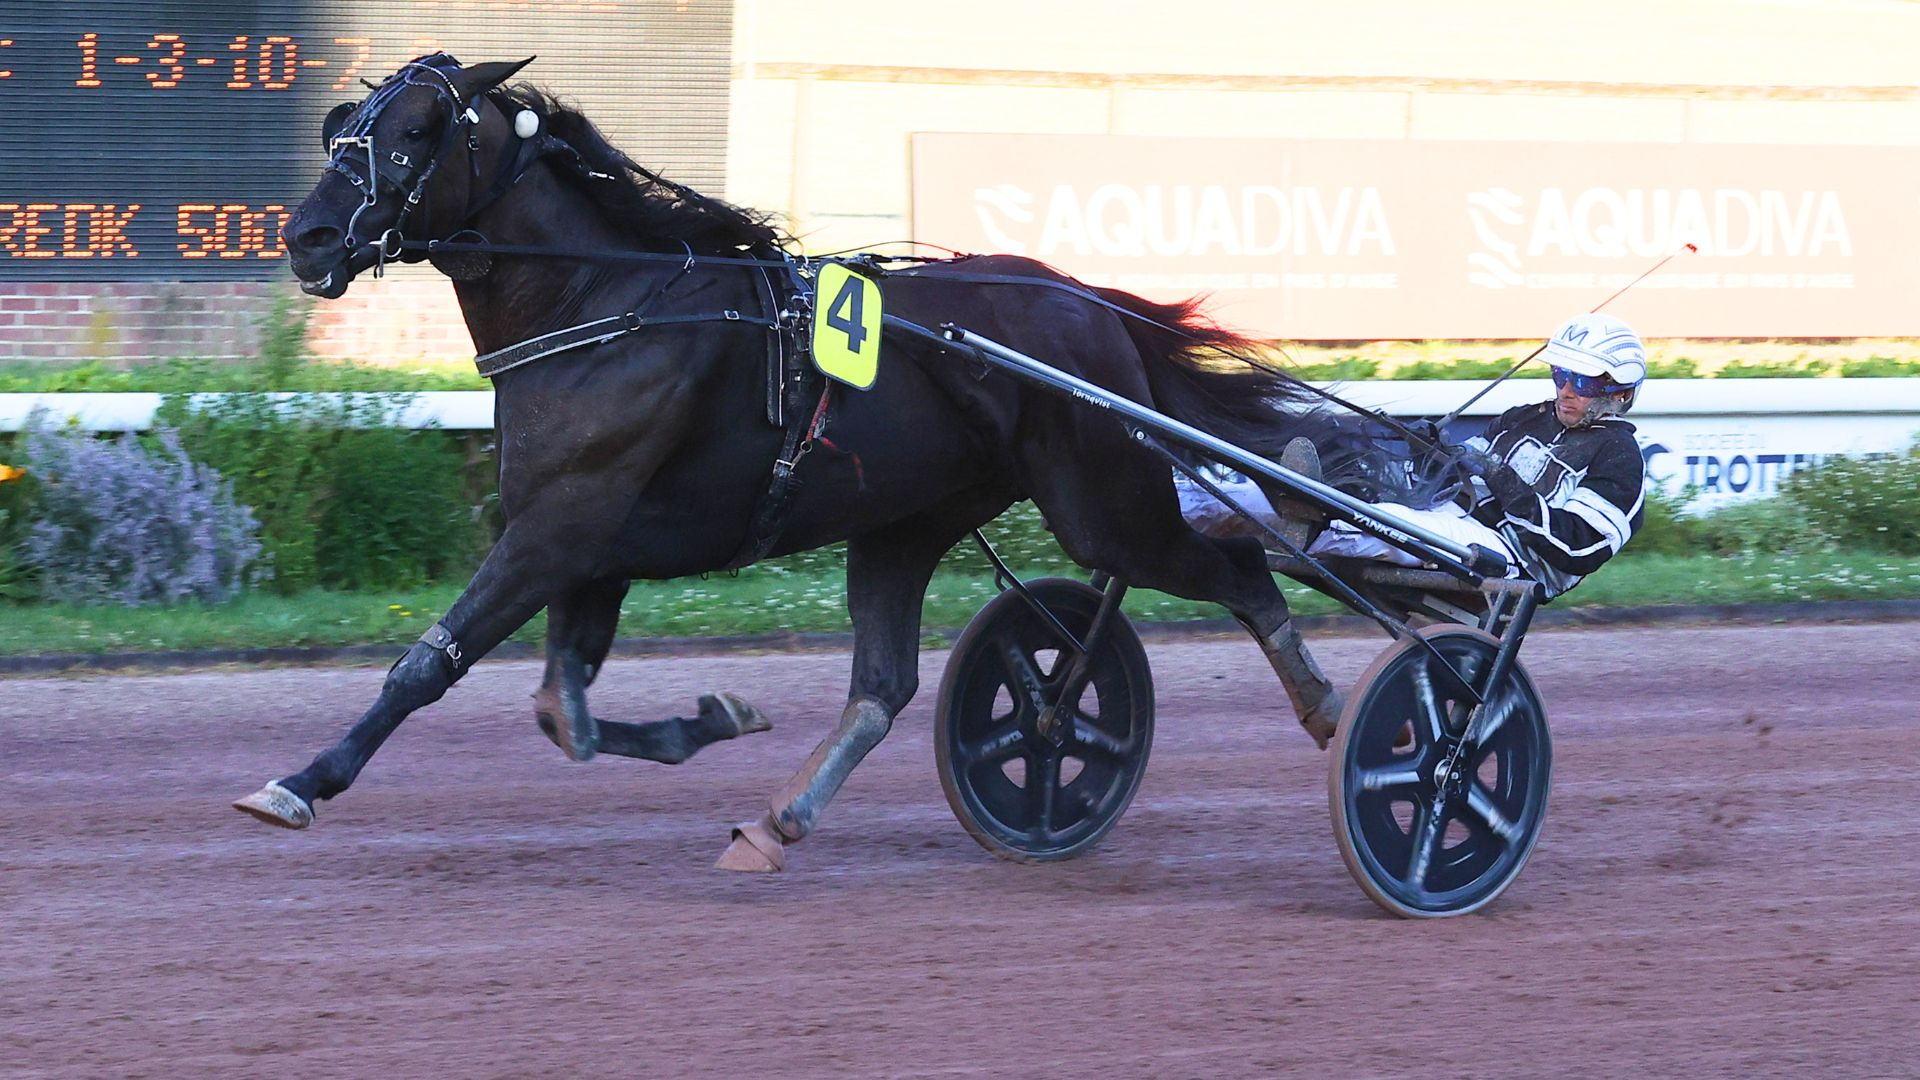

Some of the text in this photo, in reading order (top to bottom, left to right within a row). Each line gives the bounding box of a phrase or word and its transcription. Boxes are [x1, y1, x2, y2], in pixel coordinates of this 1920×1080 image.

[1038, 184, 1397, 258] AQUADIVA
[1526, 187, 1855, 258] AQUADIVA
[826, 274, 867, 354] 4
[1560, 324, 1590, 346] M
[1352, 510, 1408, 544] YANKEE
